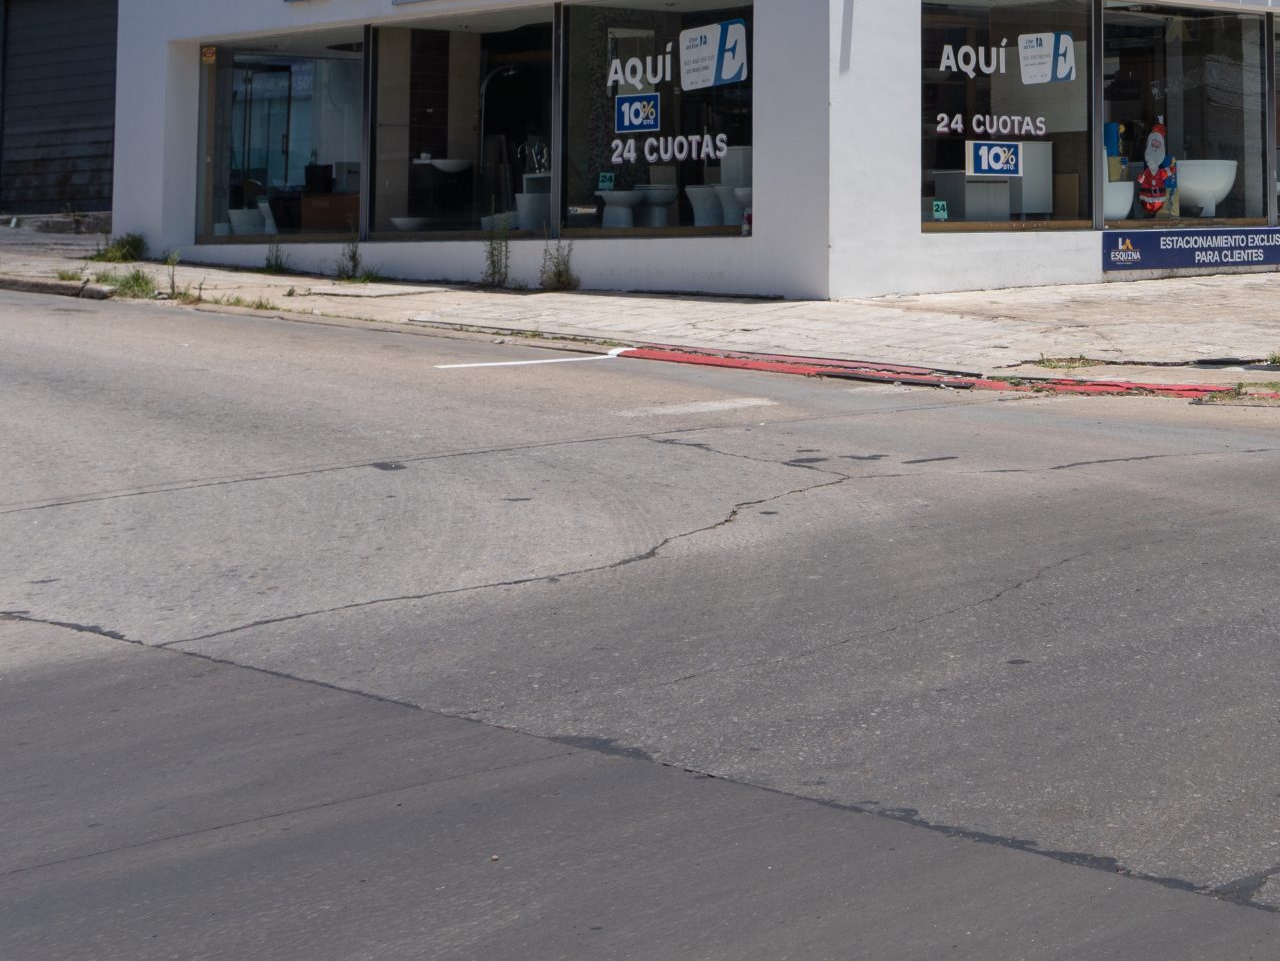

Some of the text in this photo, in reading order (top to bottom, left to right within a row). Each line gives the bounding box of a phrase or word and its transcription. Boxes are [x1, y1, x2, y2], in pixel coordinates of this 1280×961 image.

[607, 42, 673, 90] AQUÍ
[939, 37, 1008, 79] AQUÍ
[621, 101, 655, 127] 10%
[936, 113, 1046, 136] 24 CUOTAS
[611, 134, 728, 164] 24 CUOTAS
[979, 146, 1016, 170] 10%
[600, 175, 613, 184] 24
[934, 204, 946, 212] 24
[1118, 238, 1133, 249] LA
[1160, 236, 1246, 250] ESTACIONAMIENTO
[1111, 251, 1141, 260] ESQUINA
[1195, 249, 1264, 263] PARA CLIENTES
